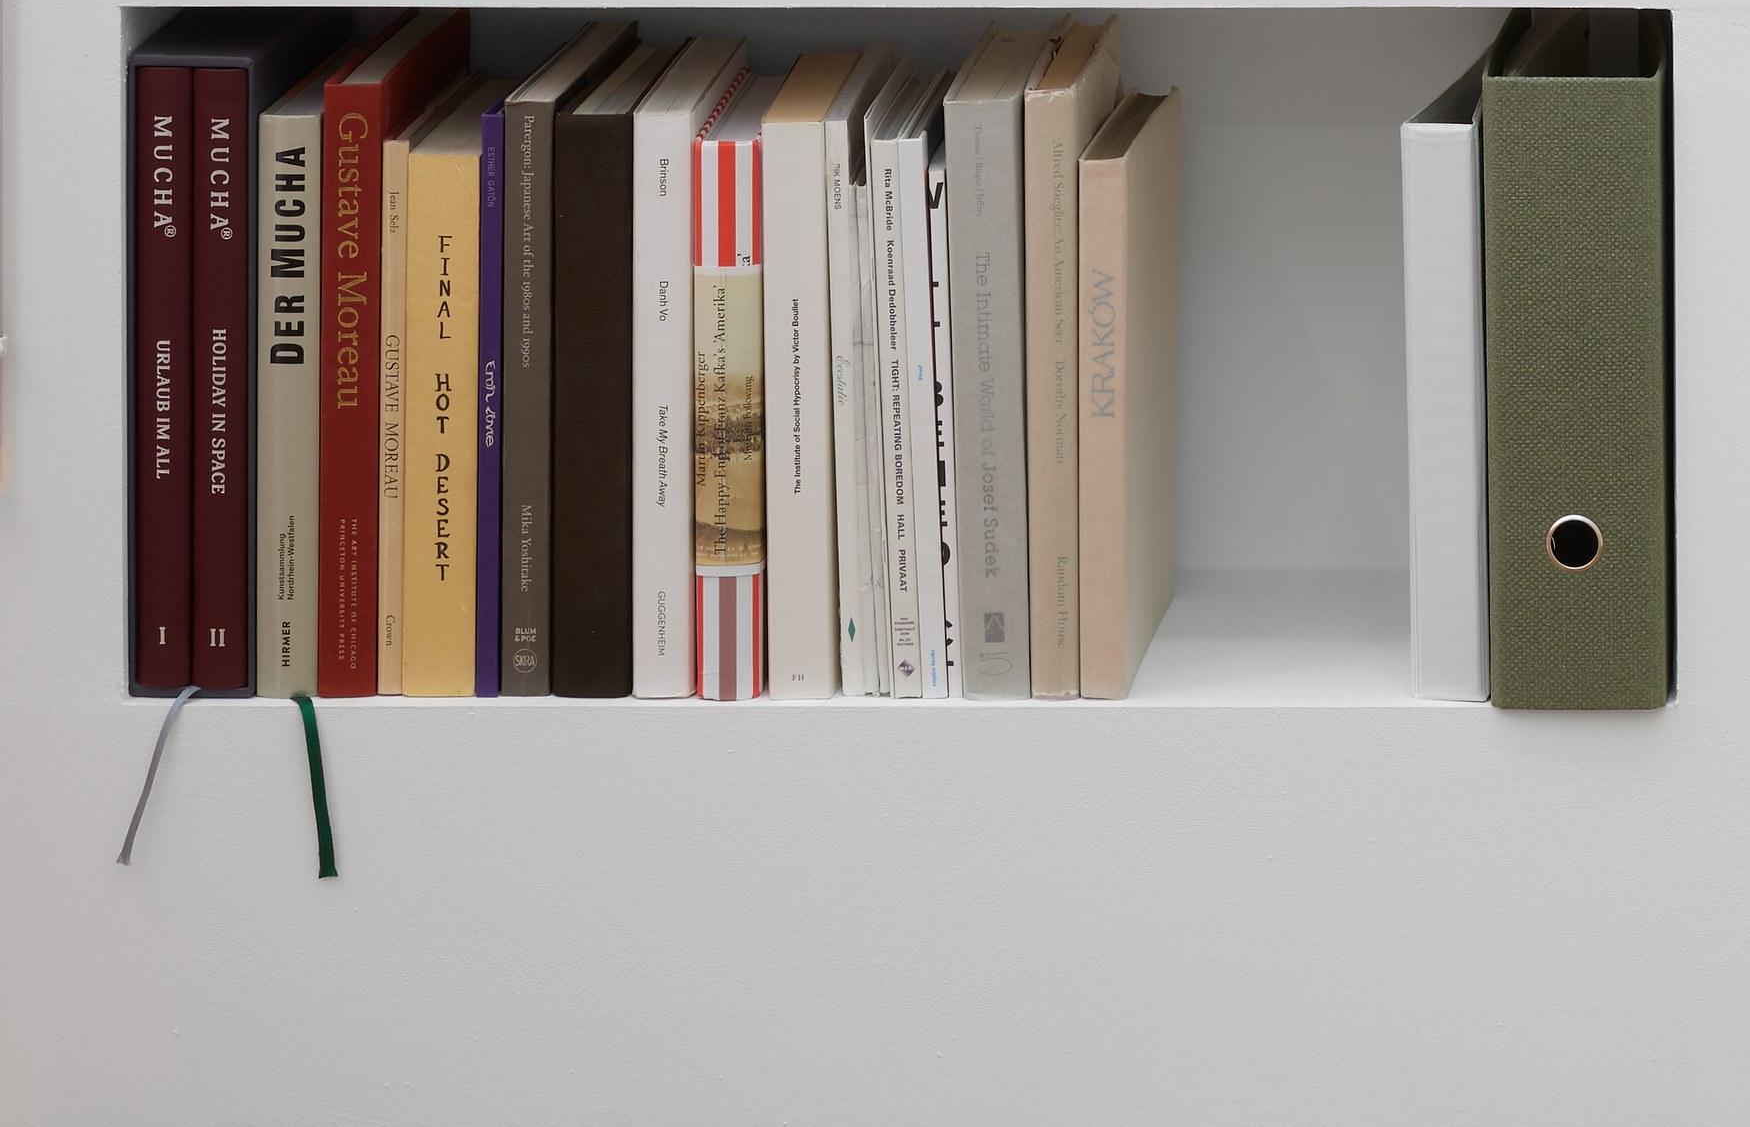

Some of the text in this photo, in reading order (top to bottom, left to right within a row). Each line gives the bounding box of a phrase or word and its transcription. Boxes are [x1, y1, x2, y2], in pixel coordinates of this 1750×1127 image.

[487, 147, 495, 179] ESTHER
[660, 159, 669, 197] Brinson
[270, 146, 306, 365] DER MUCHA
[388, 190, 400, 234] Jean Selz
[520, 114, 535, 368] Parergon: Japanese Art of the 1980s and 1990s
[336, 112, 369, 409] Gustave Moreau
[659, 281, 669, 322] Danh Vo
[1051, 140, 1066, 463] Alfred Stieglitz: An American Seer Dorothy Norman
[793, 354, 801, 364] by
[793, 366, 802, 406] Hypocrisy
[884, 168, 907, 593] Rita McBride Koenraad Dedobbeleer TIGHT: REPEATING BOREDOM HALL PRIVAAT
[1088, 268, 1116, 419] KRAKÓW
[156, 339, 171, 479] URLAUB IM ALL
[211, 328, 226, 493] HOLIDAY IN SPACE
[384, 334, 400, 499] GUSTAVE MOREAU
[434, 234, 452, 582] FINAL HOT DESERT
[696, 352, 710, 487] Martin Kippenberger
[793, 434, 801, 443] of
[975, 252, 1000, 578] The Intimate World of Josef Sudek
[657, 405, 668, 507] Take My Breath Away
[278, 534, 286, 601] Kunstsammlung
[287, 515, 296, 601] Nordrhein-Westfalen
[521, 504, 533, 592] Mika Yoshitake
[281, 621, 291, 667] HIRMER
[385, 614, 396, 646] Crown
[658, 591, 666, 656] GUGGENHEIM
[1057, 556, 1068, 649] Random House
